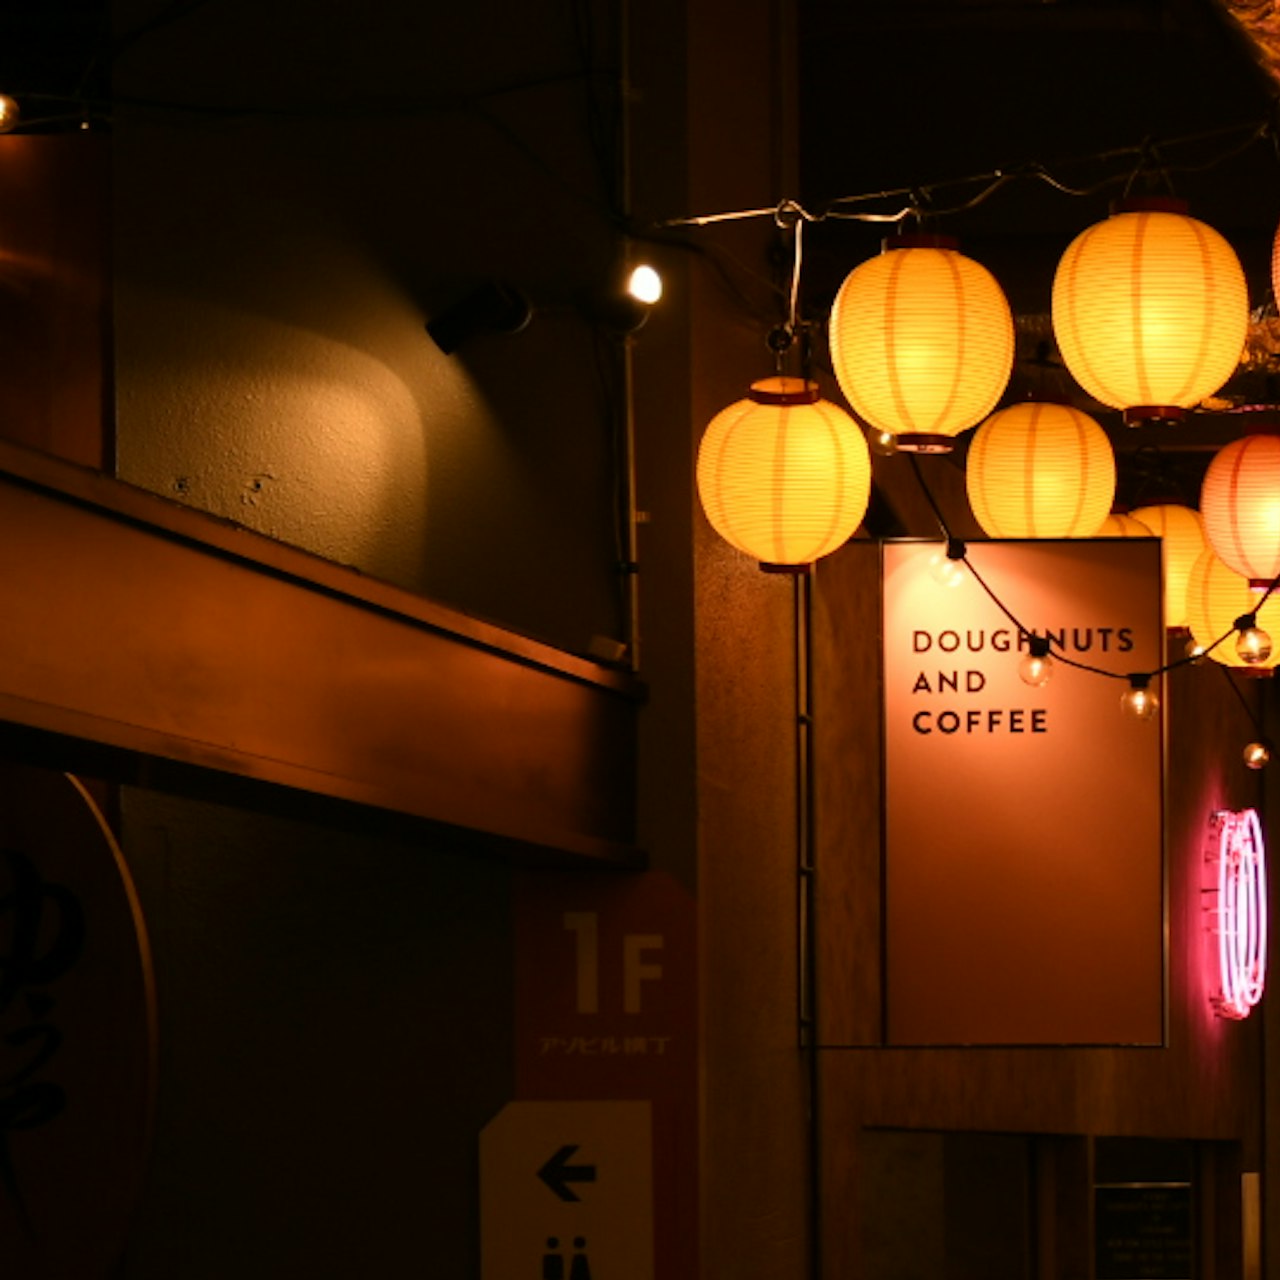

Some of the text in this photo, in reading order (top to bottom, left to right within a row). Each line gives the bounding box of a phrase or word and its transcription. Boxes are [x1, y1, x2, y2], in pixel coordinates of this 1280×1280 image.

[912, 627, 1135, 654] DOUGHNUTS
[912, 670, 987, 694] AND
[912, 709, 1049, 735] COFFEE
[563, 910, 665, 1015] 1F
